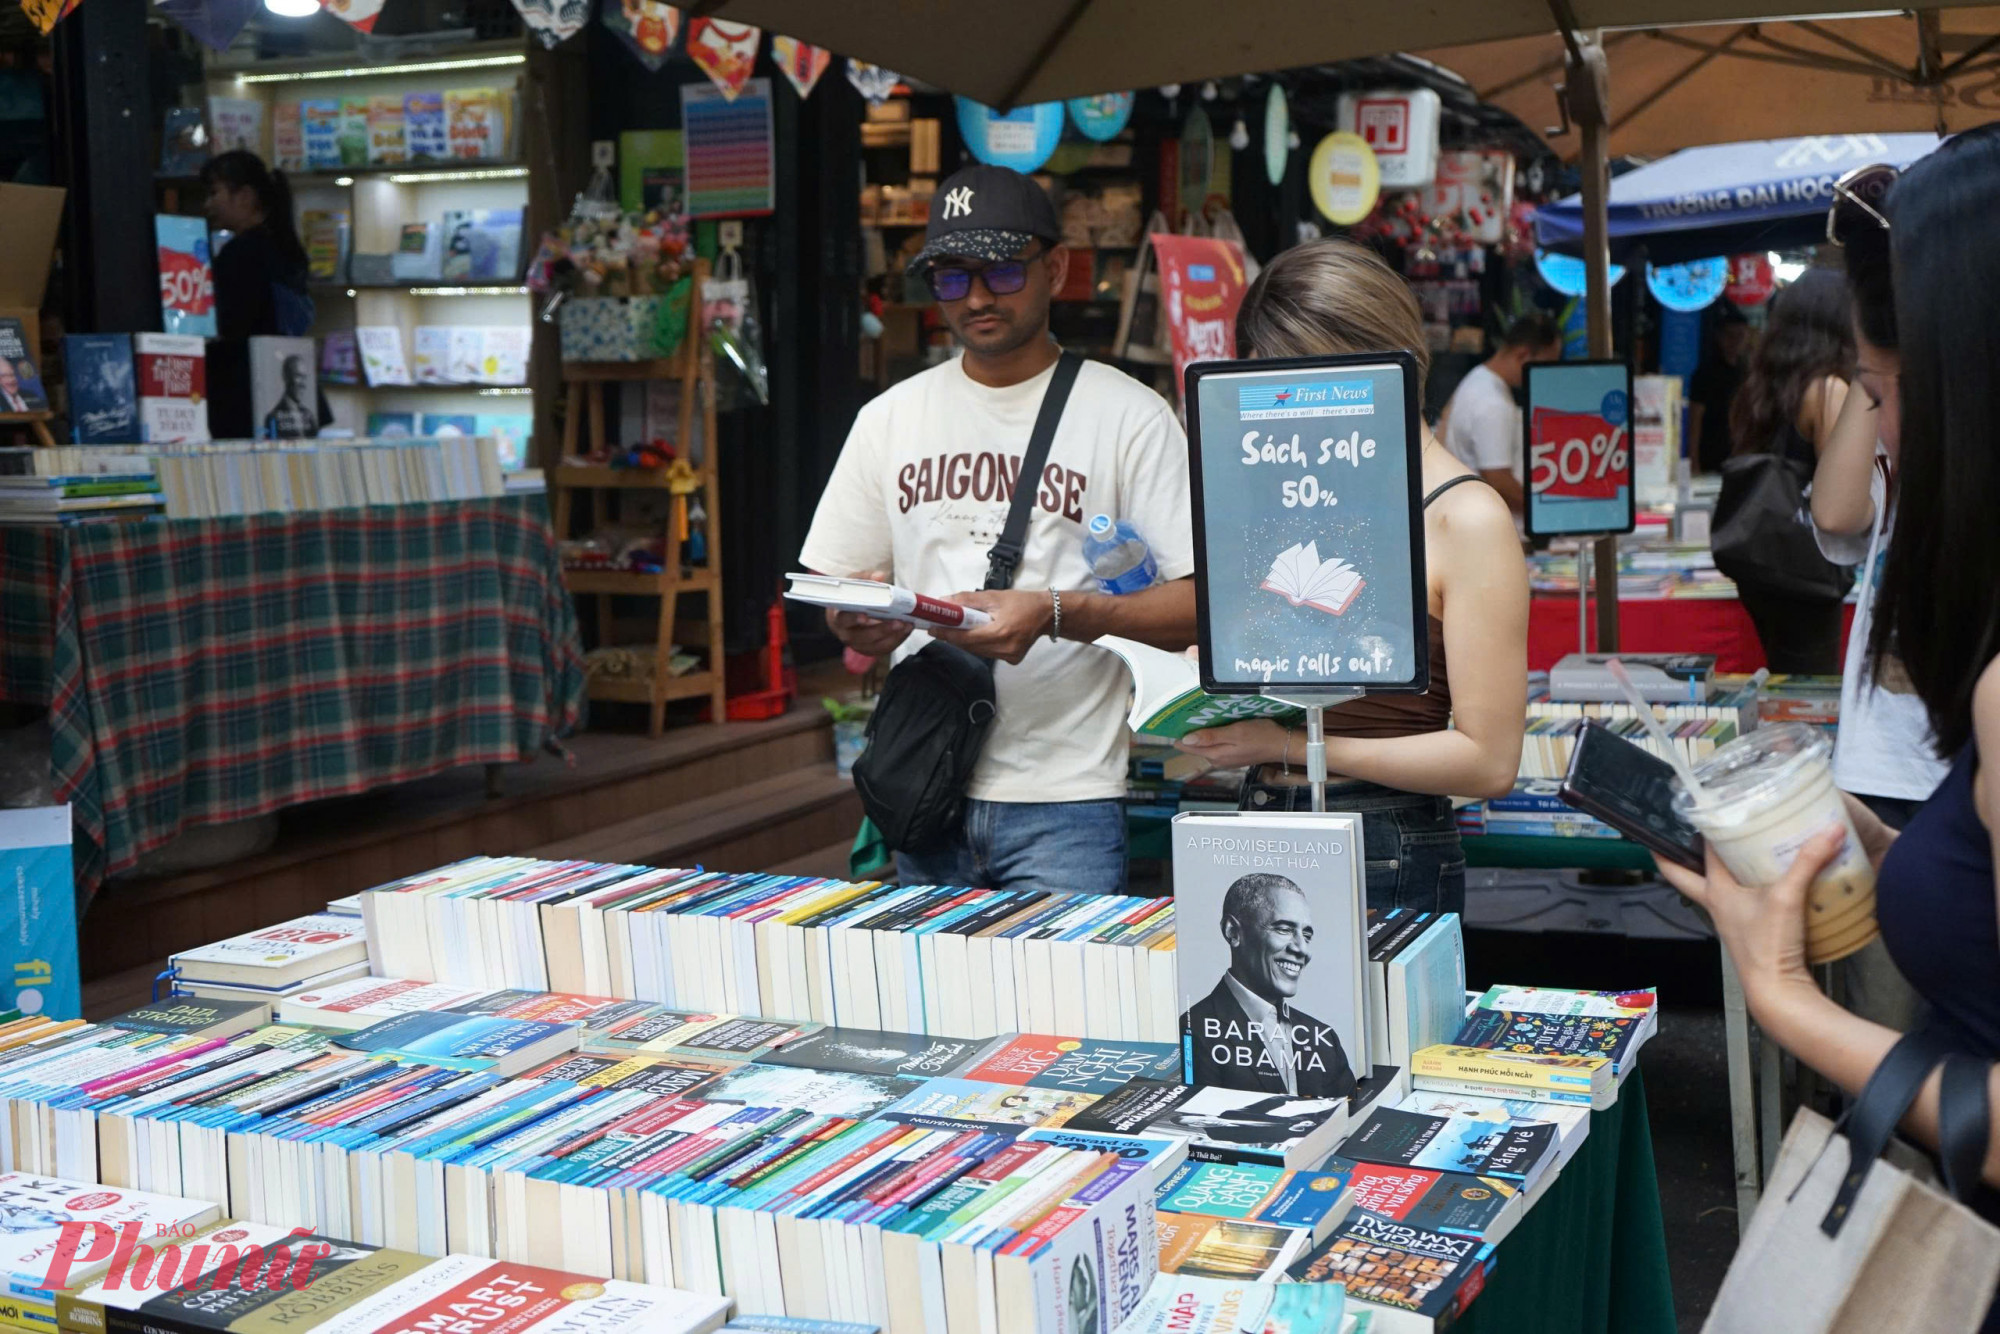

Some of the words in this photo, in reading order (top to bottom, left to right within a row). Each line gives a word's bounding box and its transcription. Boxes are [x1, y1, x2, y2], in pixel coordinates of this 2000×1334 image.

[1782, 173, 1835, 203] HỌC
[942, 186, 975, 220] NY
[1295, 387, 1328, 402] First
[1332, 385, 1368, 400] News
[1240, 411, 1263, 420] Where
[1264, 410, 1291, 419] there's
[1300, 409, 1315, 417] will
[1322, 408, 1349, 416] there's
[1357, 407, 1375, 416] way
[1241, 430, 1307, 469] Sách
[1316, 430, 1377, 468] sale
[1531, 427, 1629, 493] 50%
[898, 452, 1087, 524] SAIGONSE
[1282, 474, 1338, 508] 50%
[1235, 656, 1290, 682] magic
[1297, 654, 1341, 676] falls
[1187, 836, 1198, 849] A
[1200, 837, 1291, 853] PROMISED
[1295, 841, 1343, 855] LAND
[127, 1010, 224, 1025] STRATEGY
[166, 1004, 219, 1018] DATA
[1204, 1017, 1334, 1048] BARACK
[1010, 1050, 1059, 1075] BIG
[1211, 1044, 1327, 1073] OBAMA
[647, 1070, 711, 1097] MAYB
[1458, 1065, 1479, 1075] HẠNH
[1480, 1067, 1499, 1077] PHÚC
[1500, 1069, 1514, 1078] MỖI
[1515, 1070, 1533, 1080] NGÀY
[1531, 1089, 1537, 1099] 8
[909, 1115, 954, 1129] NGUYÊN
[955, 1120, 990, 1131] PHONG
[1035, 1141, 1150, 1159] ONO
[1053, 1134, 1119, 1148] Edward
[1124, 1139, 1144, 1148] de
[1514, 1130, 1535, 1145] vẻ
[1125, 1204, 1140, 1280] MARS
[269, 1261, 401, 1325] ROBBINS
[270, 1265, 367, 1313] ANTHONY
[69, 1311, 103, 1328] ROBBINS
